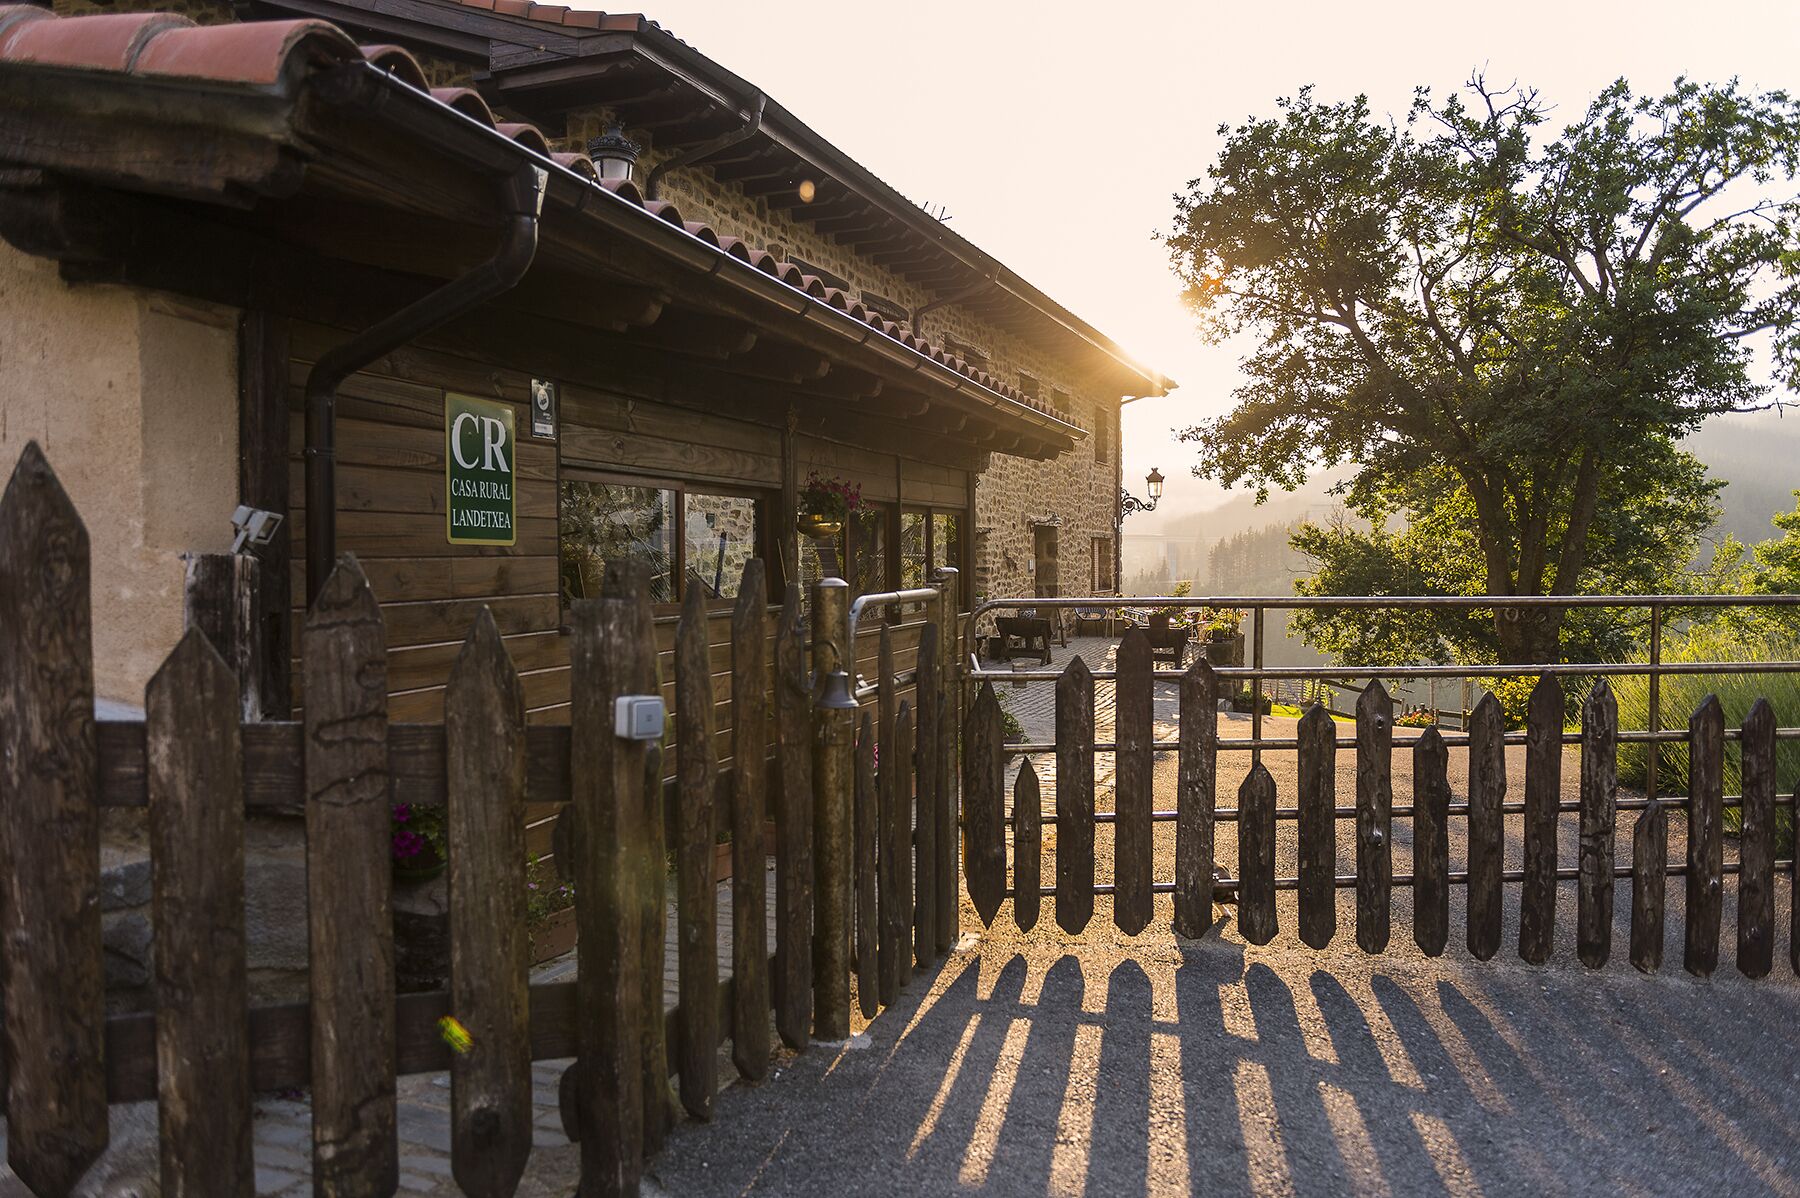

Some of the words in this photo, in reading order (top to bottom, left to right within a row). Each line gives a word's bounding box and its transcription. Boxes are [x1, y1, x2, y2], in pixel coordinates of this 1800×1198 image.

[452, 412, 511, 473] CR
[452, 478, 480, 499] CASA
[480, 481, 511, 501] RURAL
[452, 508, 511, 529] LANDETXEA
